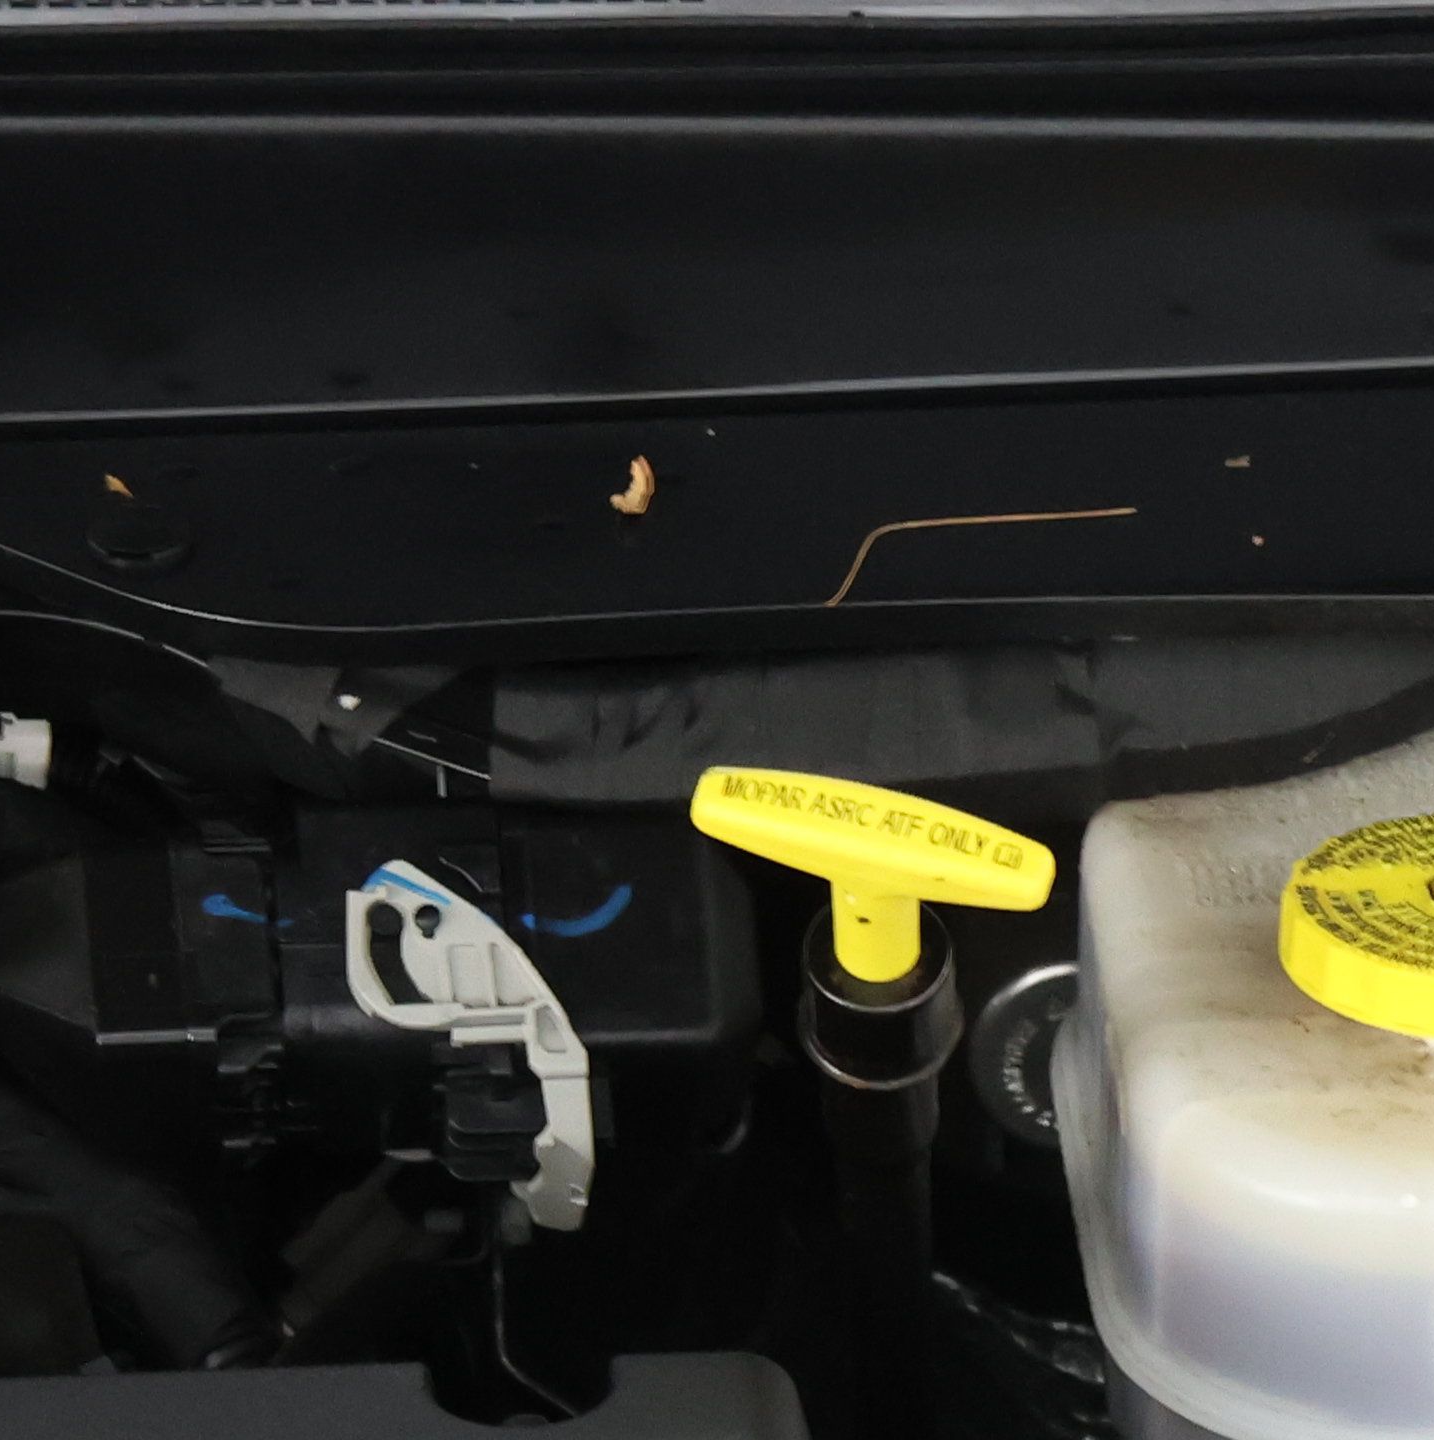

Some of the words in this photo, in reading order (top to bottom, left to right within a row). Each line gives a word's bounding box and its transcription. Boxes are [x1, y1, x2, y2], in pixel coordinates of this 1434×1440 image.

[721, 774, 807, 811] MOPAR
[877, 809, 925, 835] ATF
[928, 822, 990, 857] ONLY
